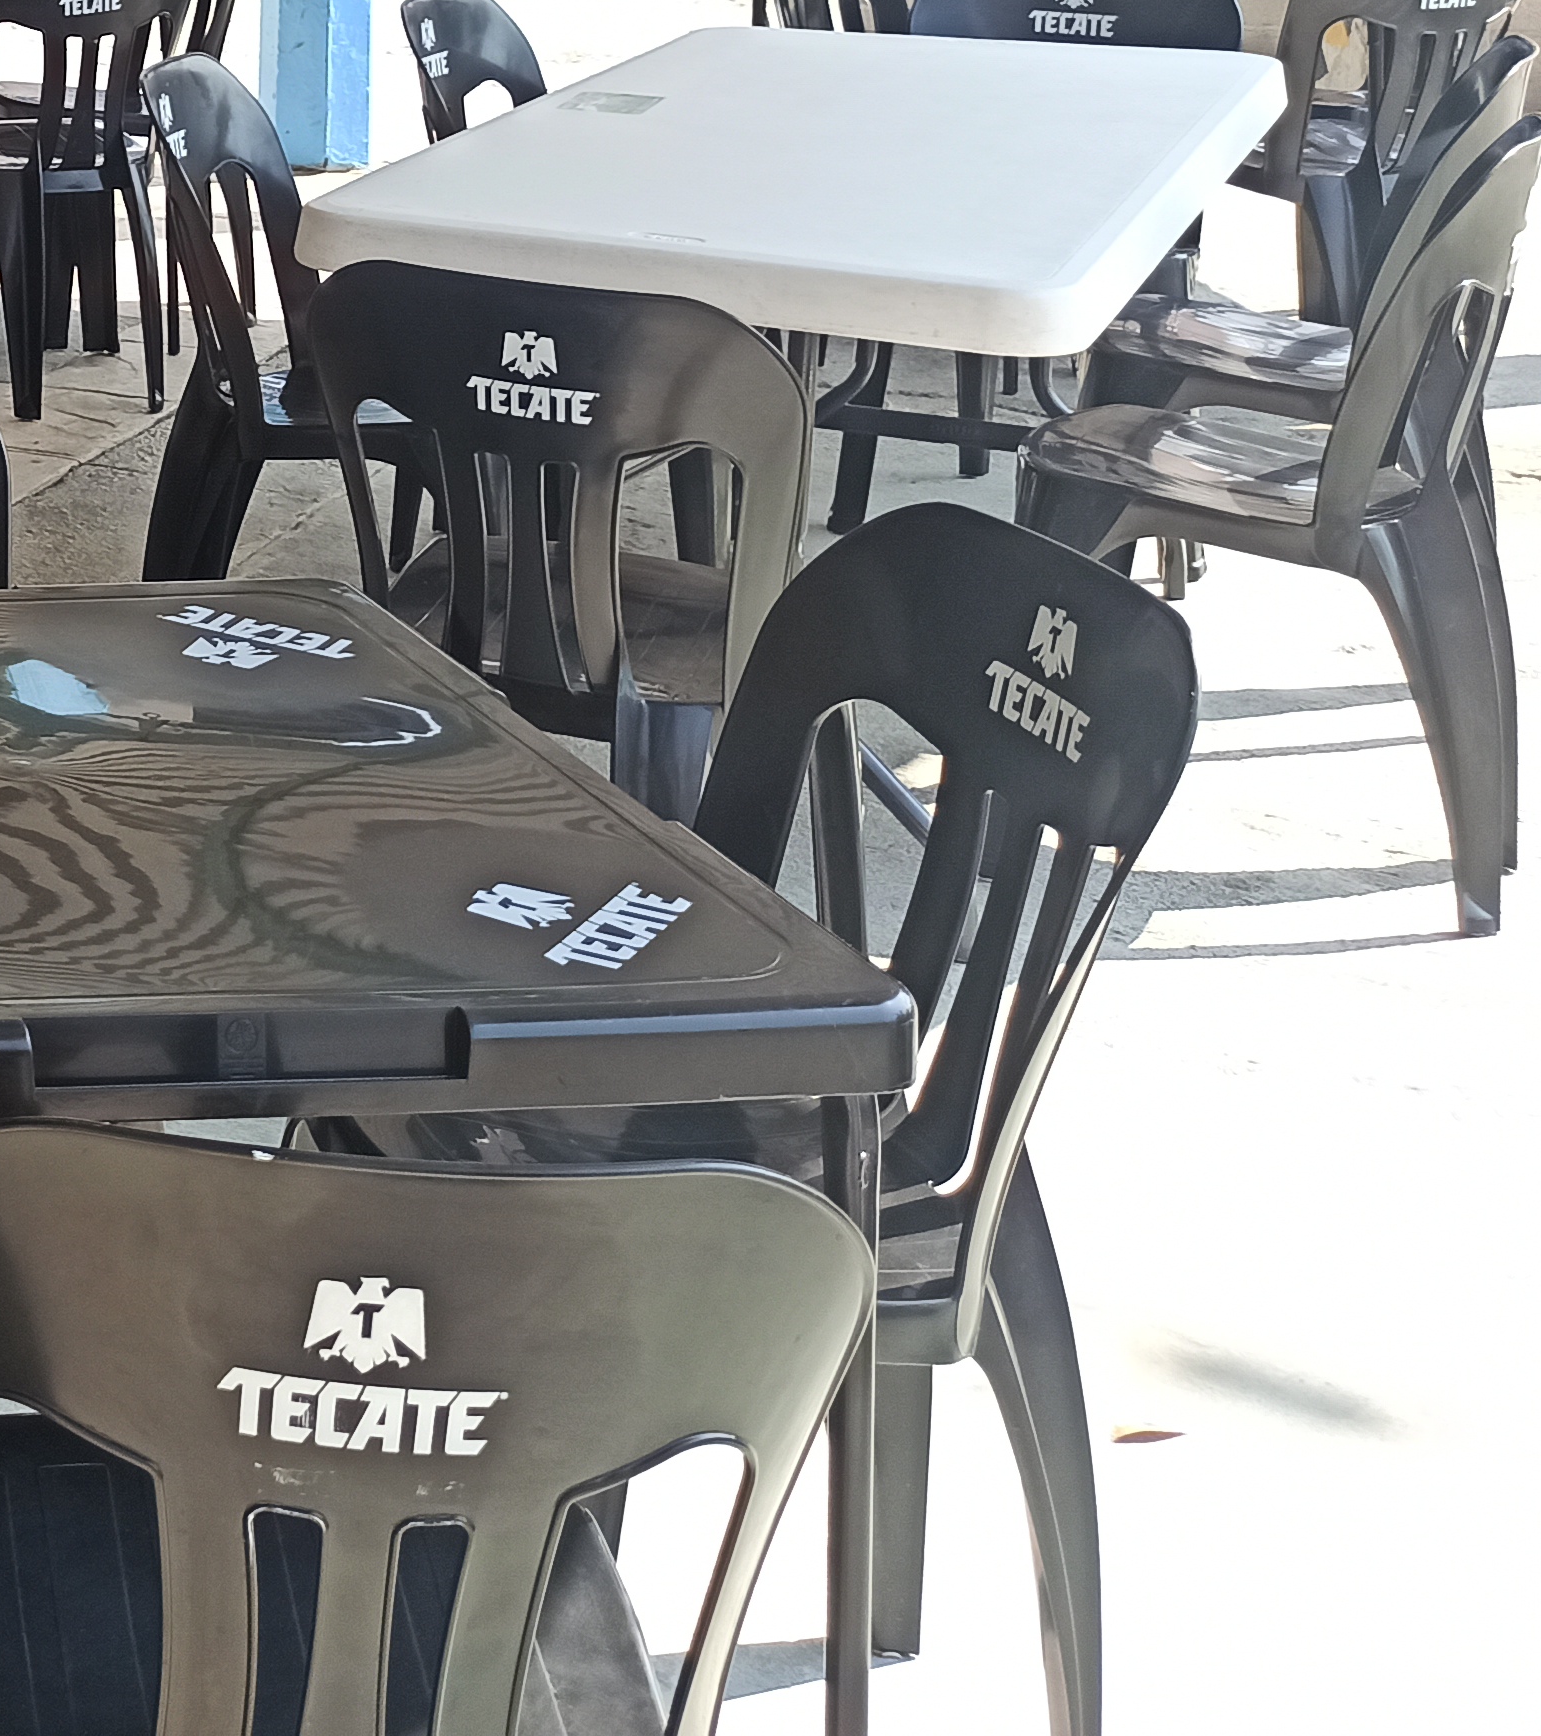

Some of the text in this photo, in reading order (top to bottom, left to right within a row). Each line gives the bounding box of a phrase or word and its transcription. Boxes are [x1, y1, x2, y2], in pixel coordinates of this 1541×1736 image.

[1029, 10, 1118, 38] TECATE
[467, 375, 600, 425] TECATE
[157, 605, 355, 661] TECATE
[985, 660, 1091, 763] TECATE
[543, 881, 693, 970] TECATE
[217, 1366, 510, 1457] TECATE
